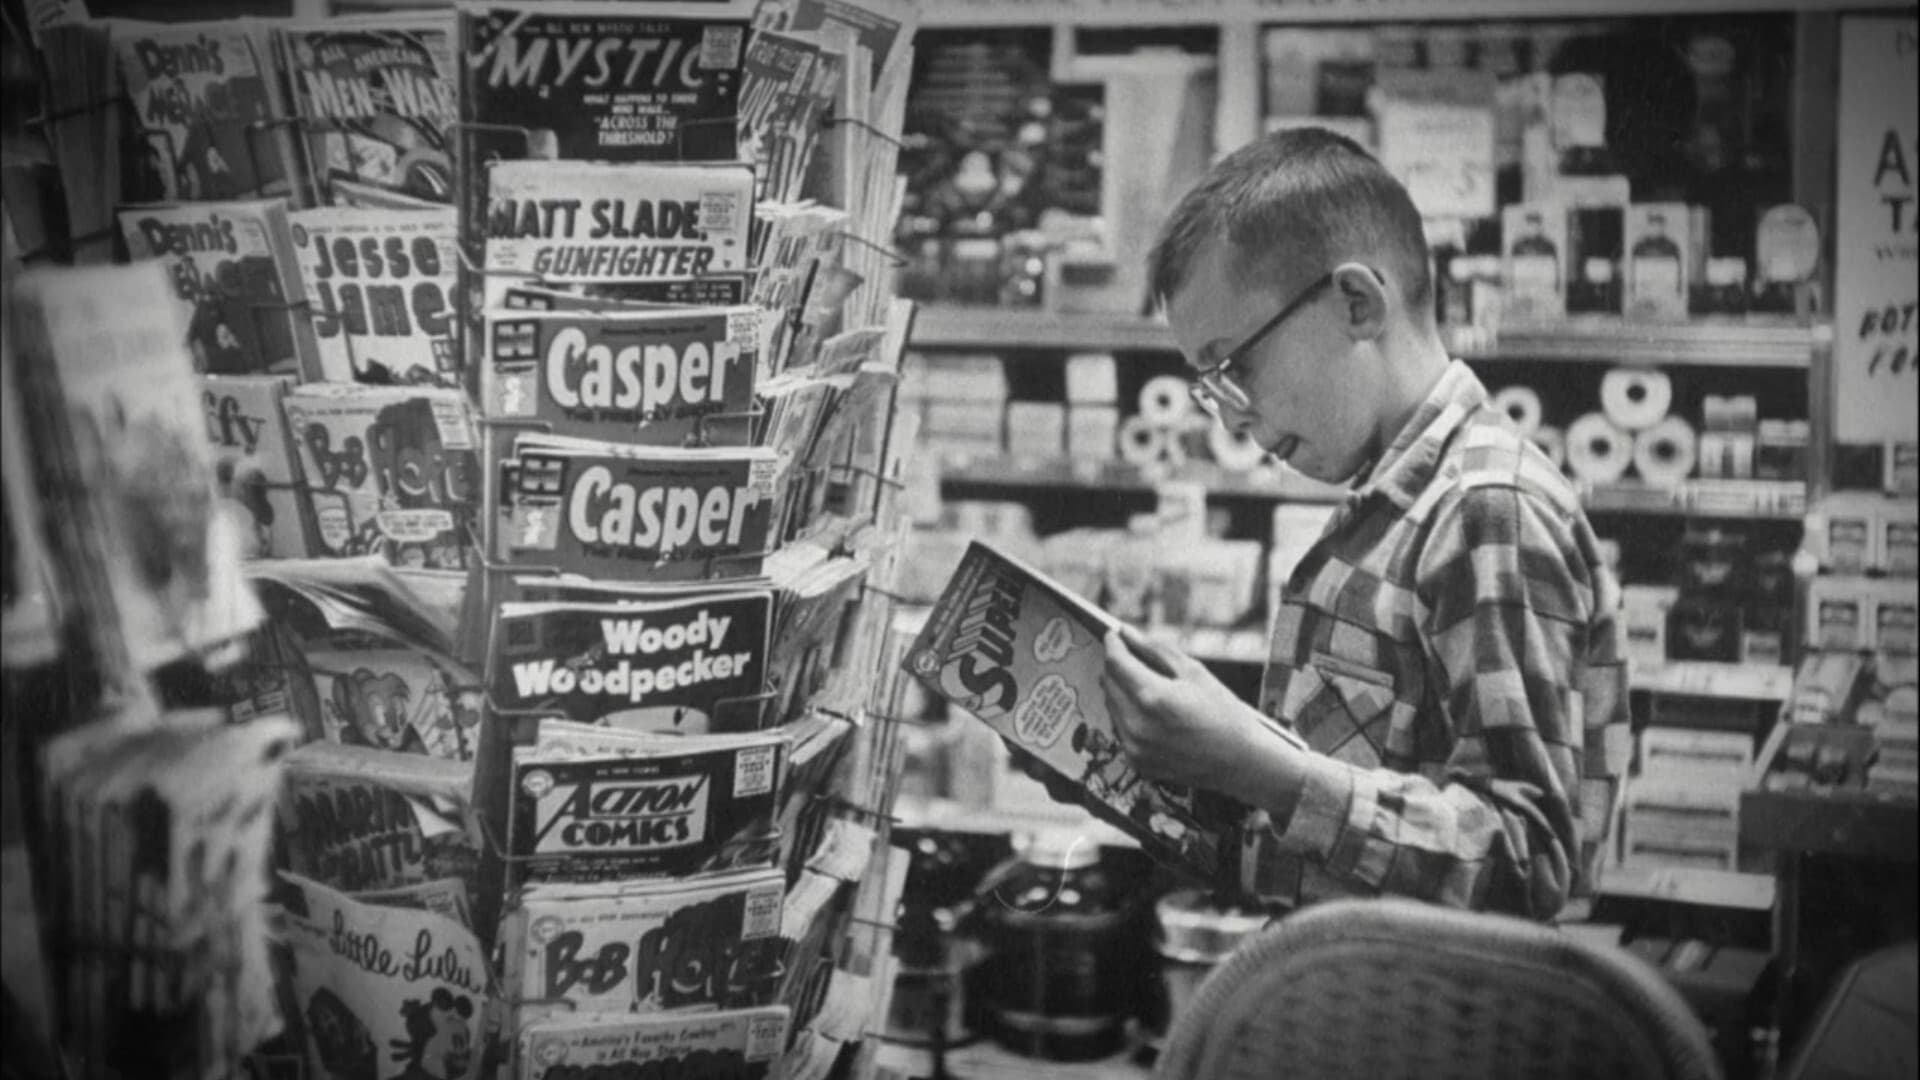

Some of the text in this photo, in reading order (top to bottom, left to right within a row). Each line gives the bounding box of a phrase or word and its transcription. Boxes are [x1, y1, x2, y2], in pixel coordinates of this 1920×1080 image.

[133, 33, 225, 79] Dennis
[488, 36, 705, 88] MYSTIC
[303, 68, 375, 118] MEN
[138, 212, 238, 256] Dennis
[313, 234, 442, 279] Jesse
[534, 245, 715, 277] GUNFIGHTER
[547, 327, 741, 412] Casper
[569, 465, 763, 553] Casper
[600, 609, 732, 655] Woody
[512, 649, 751, 704] Woodpecker
[536, 774, 709, 839] ACTION
[560, 815, 690, 848] COMICS
[329, 908, 481, 994] Little Lulu
